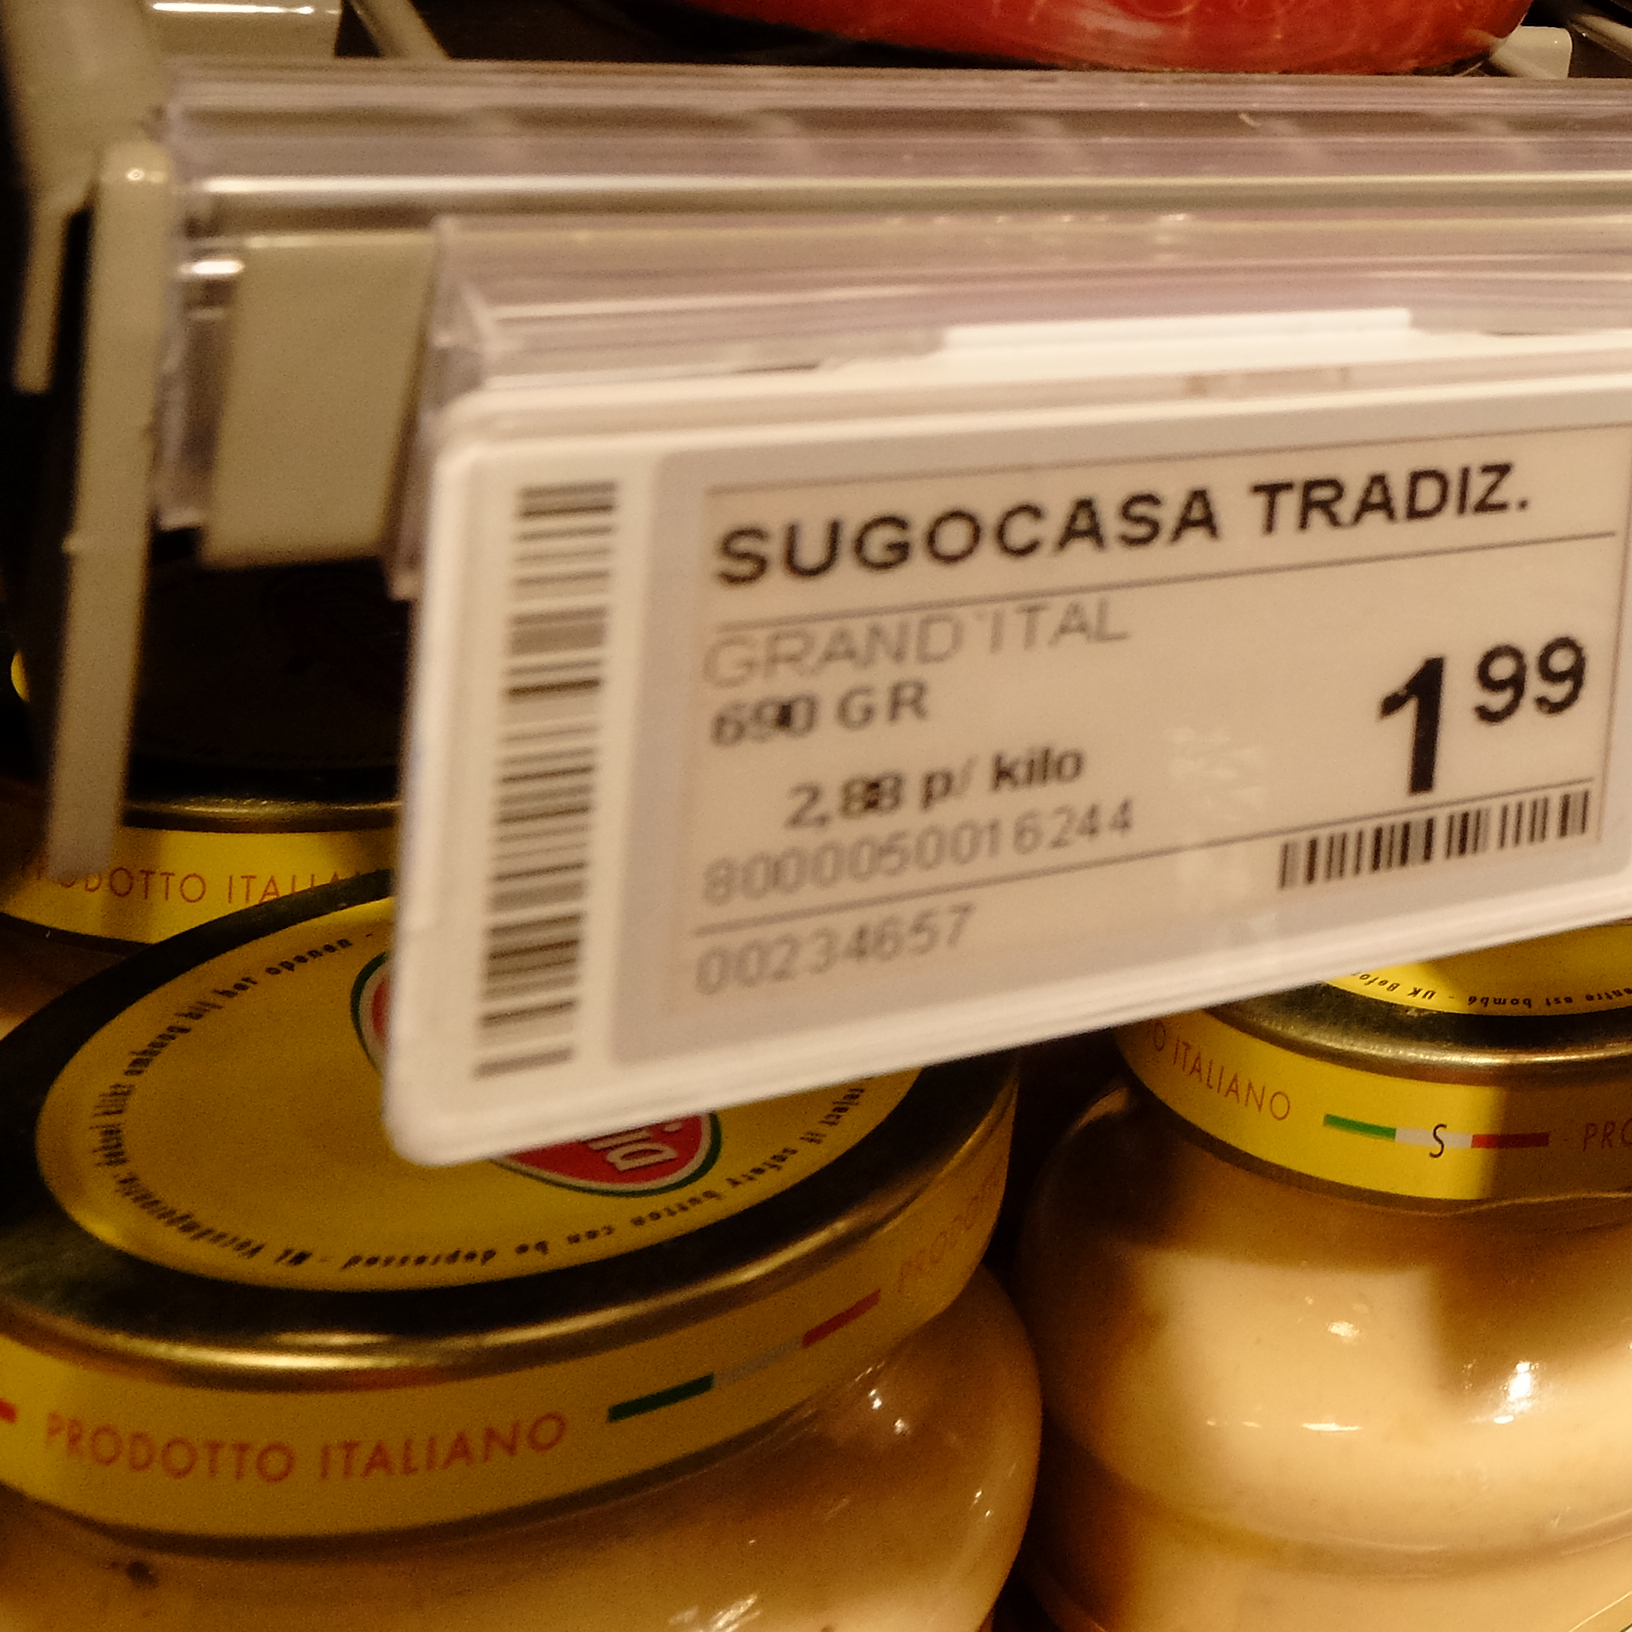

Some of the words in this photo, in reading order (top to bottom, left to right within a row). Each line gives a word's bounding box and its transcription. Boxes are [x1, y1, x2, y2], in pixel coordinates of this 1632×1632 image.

[716, 486, 1224, 589] SUGOCASA
[1250, 458, 1533, 539] TRADIZ.
[709, 692, 822, 748] 690
[836, 676, 930, 731] GR
[783, 770, 908, 832] 2,88
[988, 745, 1087, 794] kilo
[695, 900, 978, 997] 00234657
[1169, 1033, 1294, 1124] ITALIANO
[1428, 1121, 1449, 1160] S
[44, 1409, 297, 1484] PRODOTTO
[317, 1410, 570, 1482] ITALIANO
